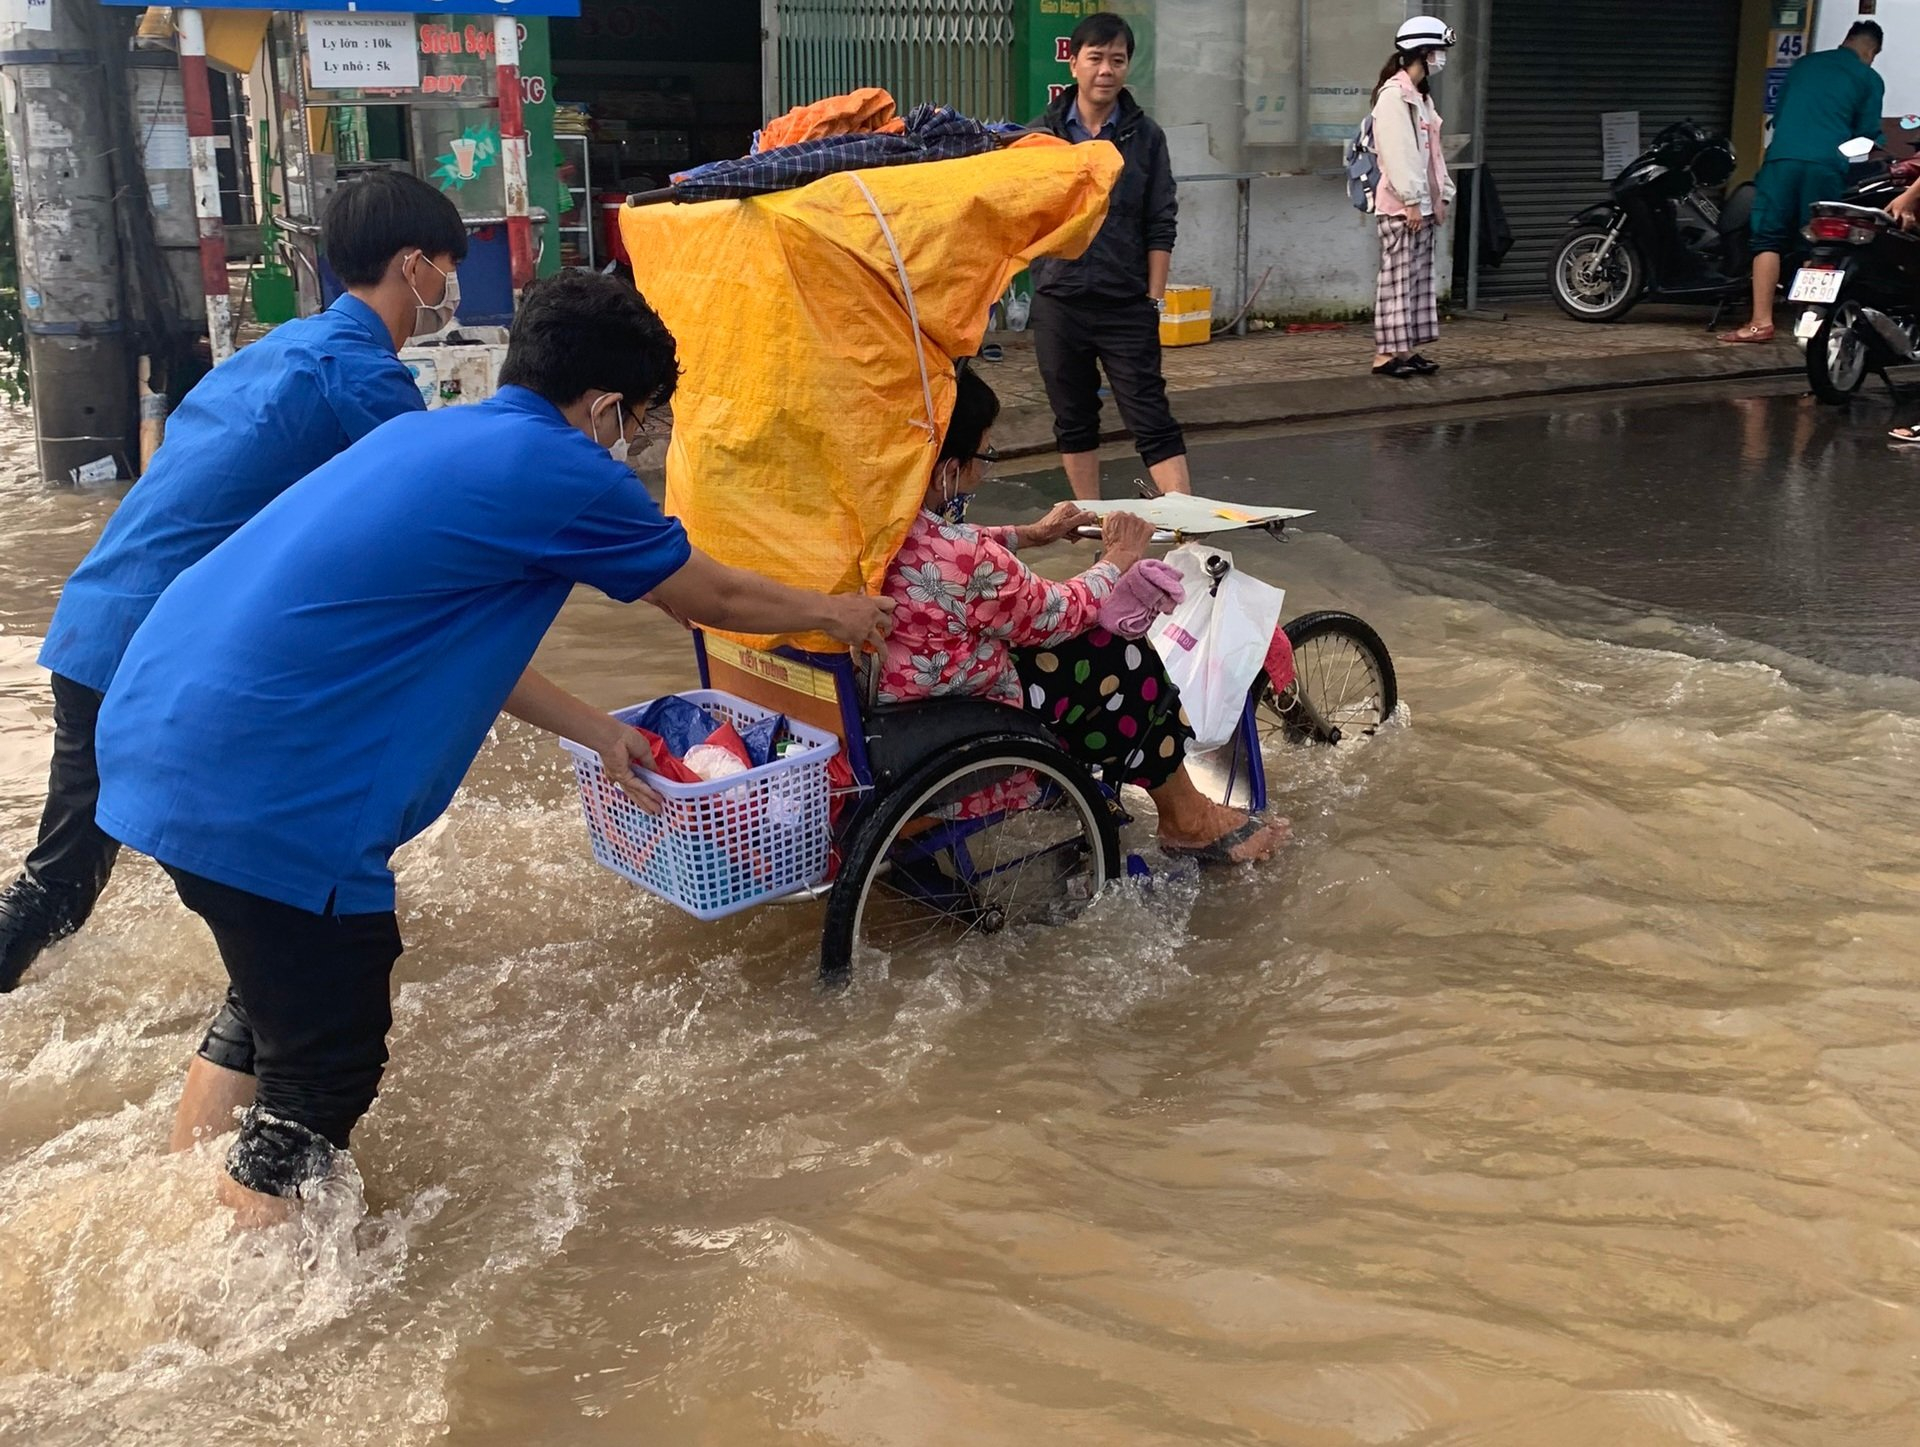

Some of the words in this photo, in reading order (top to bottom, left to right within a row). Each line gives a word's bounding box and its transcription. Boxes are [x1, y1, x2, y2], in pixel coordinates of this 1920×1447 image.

[322, 38, 336, 50] Ly
[340, 38, 358, 48] lớn
[372, 38, 392, 48] 10k
[1779, 35, 1802, 56] 45
[324, 61, 339, 73] Ly
[342, 60, 363, 71] nhỏ
[377, 61, 390, 71] 5k
